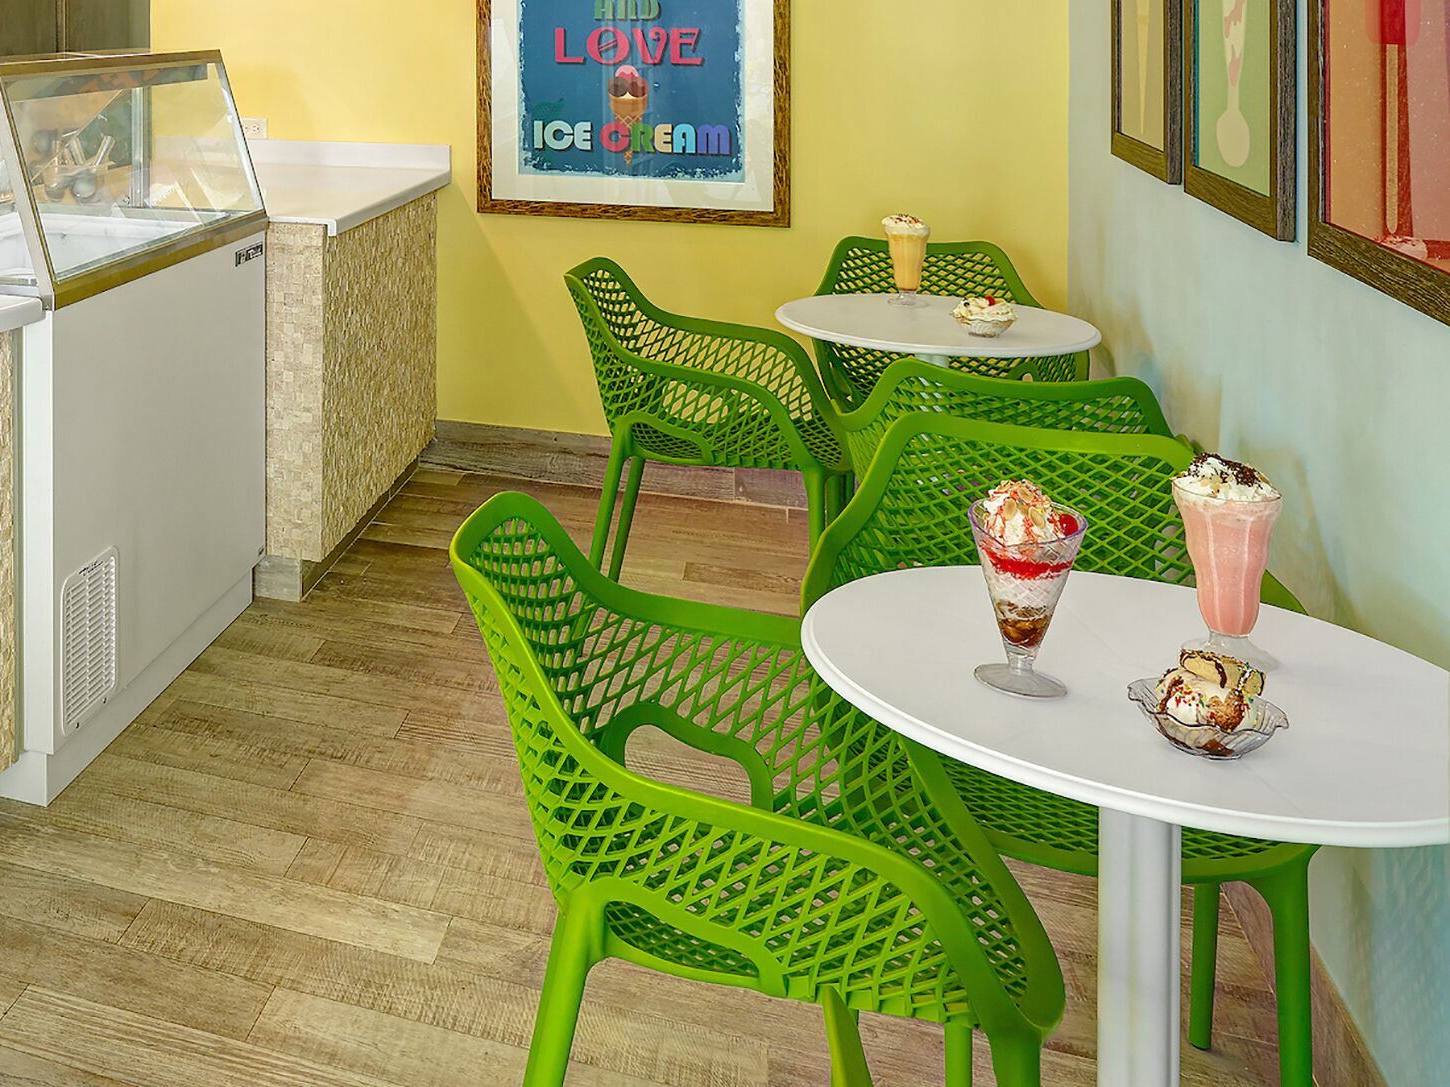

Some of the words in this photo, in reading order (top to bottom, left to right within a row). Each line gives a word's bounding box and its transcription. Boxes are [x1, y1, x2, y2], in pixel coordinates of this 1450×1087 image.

[555, 27, 704, 65] LOVE
[533, 120, 592, 151] ICE
[600, 123, 732, 155] CREAM
